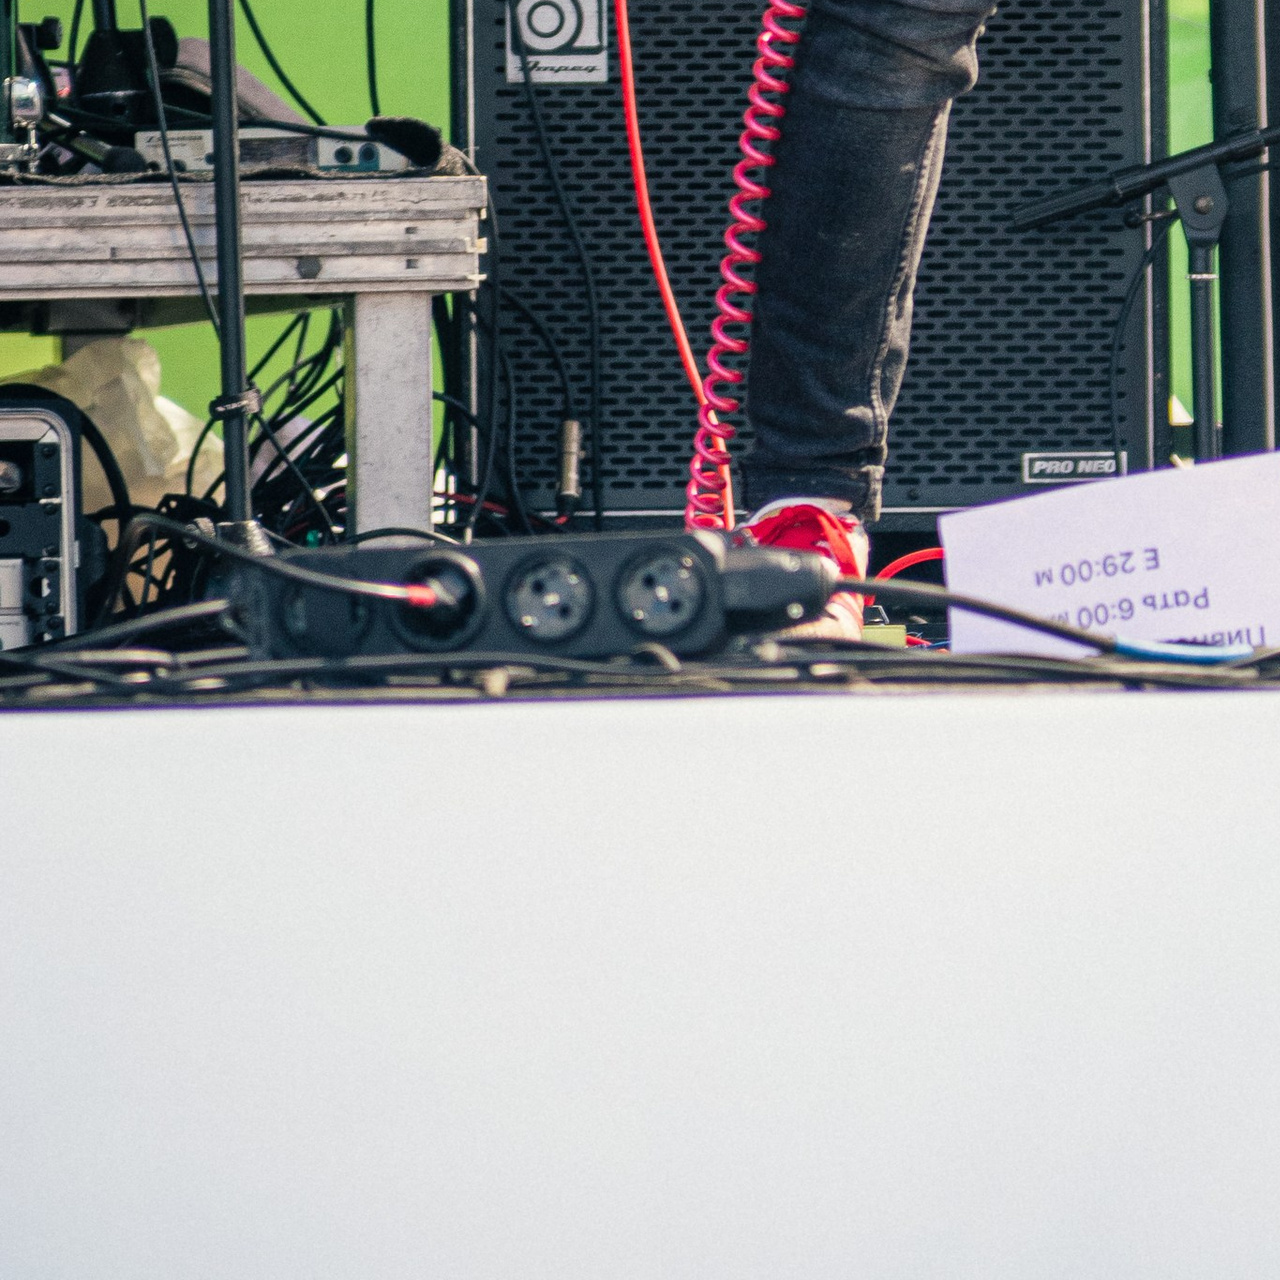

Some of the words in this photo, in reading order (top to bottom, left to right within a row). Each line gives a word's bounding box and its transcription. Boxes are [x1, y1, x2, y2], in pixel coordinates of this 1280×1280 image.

[1032, 460, 1075, 474] PRO
[1077, 459, 1117, 473] NEO
[1060, 551, 1136, 587] 29:00
[1077, 598, 1135, 631] 6:00
